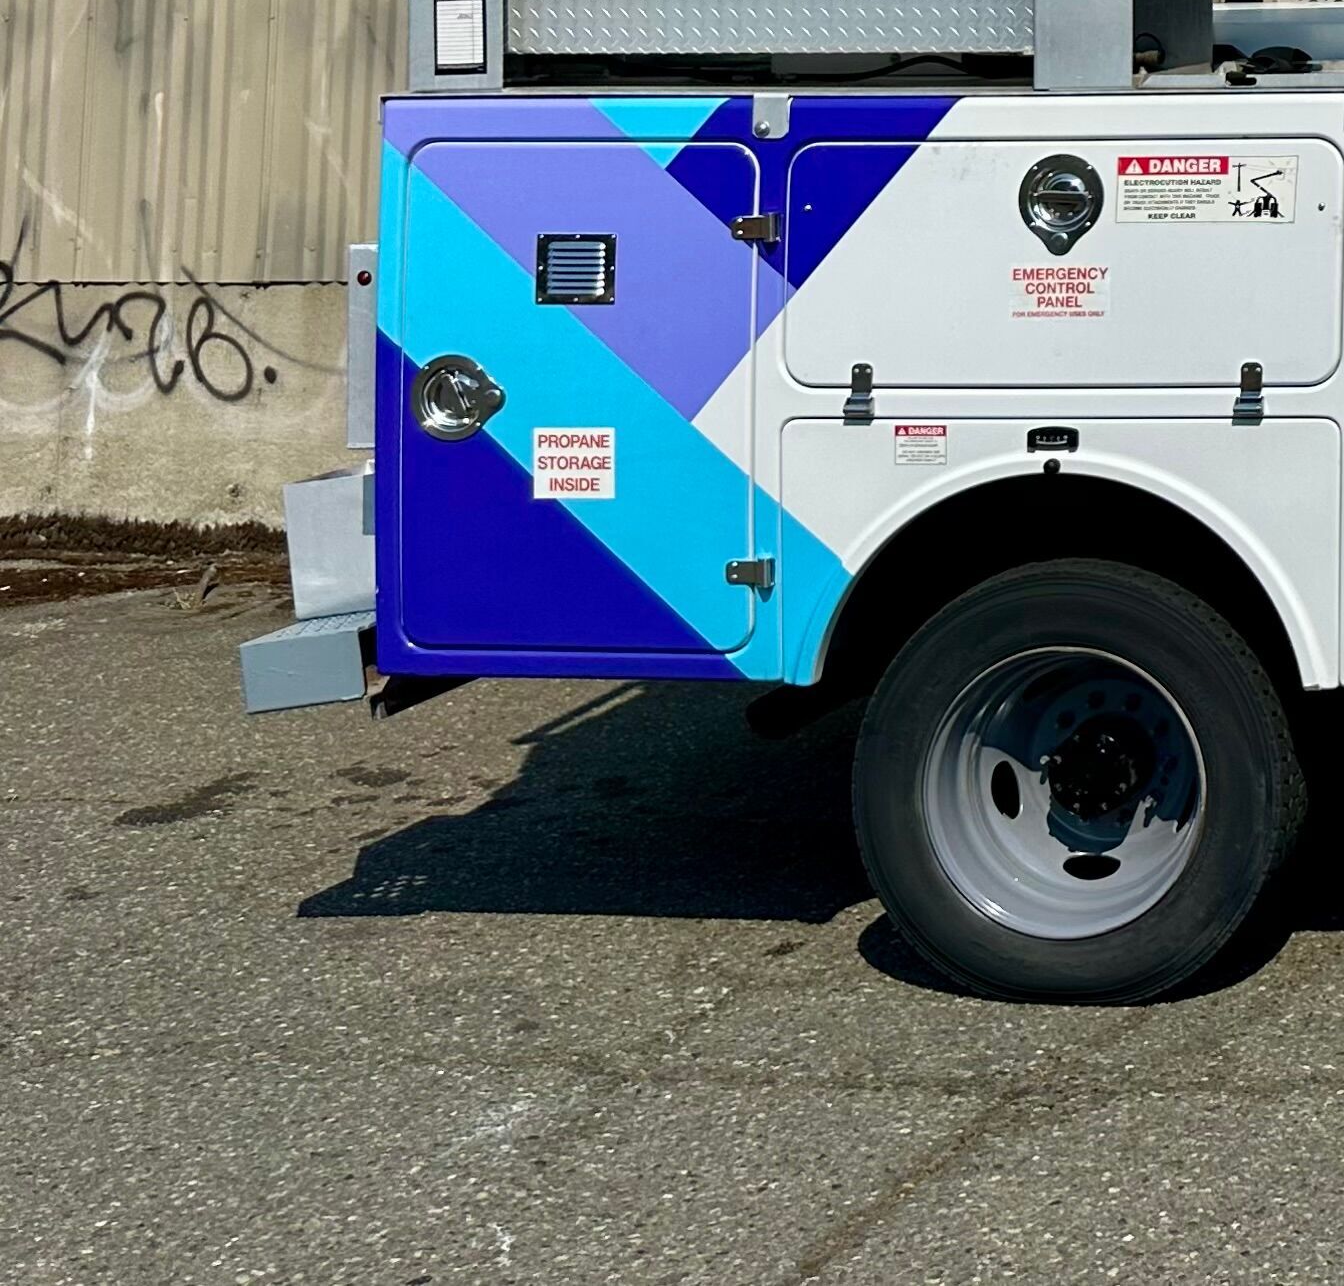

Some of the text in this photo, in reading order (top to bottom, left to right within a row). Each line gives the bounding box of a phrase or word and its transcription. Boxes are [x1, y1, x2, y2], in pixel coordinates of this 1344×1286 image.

[1149, 159, 1222, 174] DANGER
[1012, 267, 1109, 281] EMERGENCY
[1025, 282, 1095, 295] CONTROL
[1037, 296, 1083, 308] PANEL
[908, 426, 944, 435] DANGER
[537, 434, 611, 449] PROPANE
[537, 455, 612, 471] STORAGE
[549, 477, 601, 492] INSIDE
